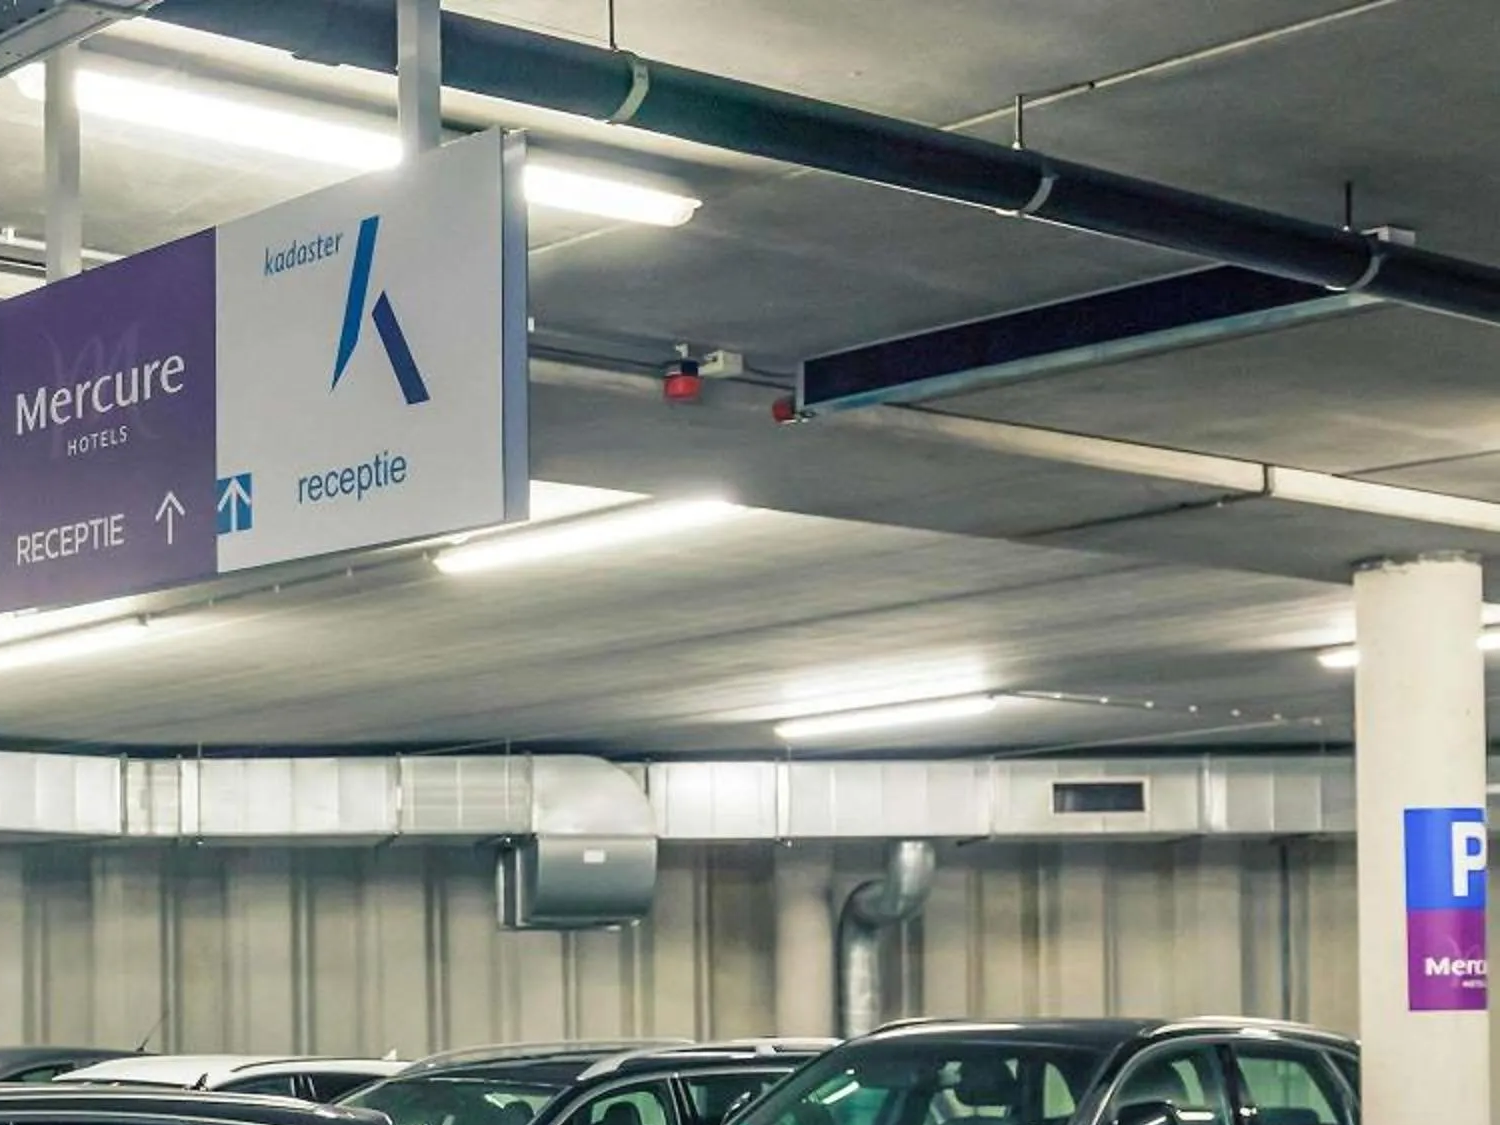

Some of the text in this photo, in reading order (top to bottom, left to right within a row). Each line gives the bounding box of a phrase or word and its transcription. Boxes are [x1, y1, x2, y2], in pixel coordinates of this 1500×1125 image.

[263, 231, 343, 276] kadaster
[16, 354, 185, 436] Mercure
[67, 426, 128, 456] HOTELS
[298, 450, 408, 504] receptie
[16, 513, 125, 566] RECEPTIE
[1451, 821, 1487, 897] P
